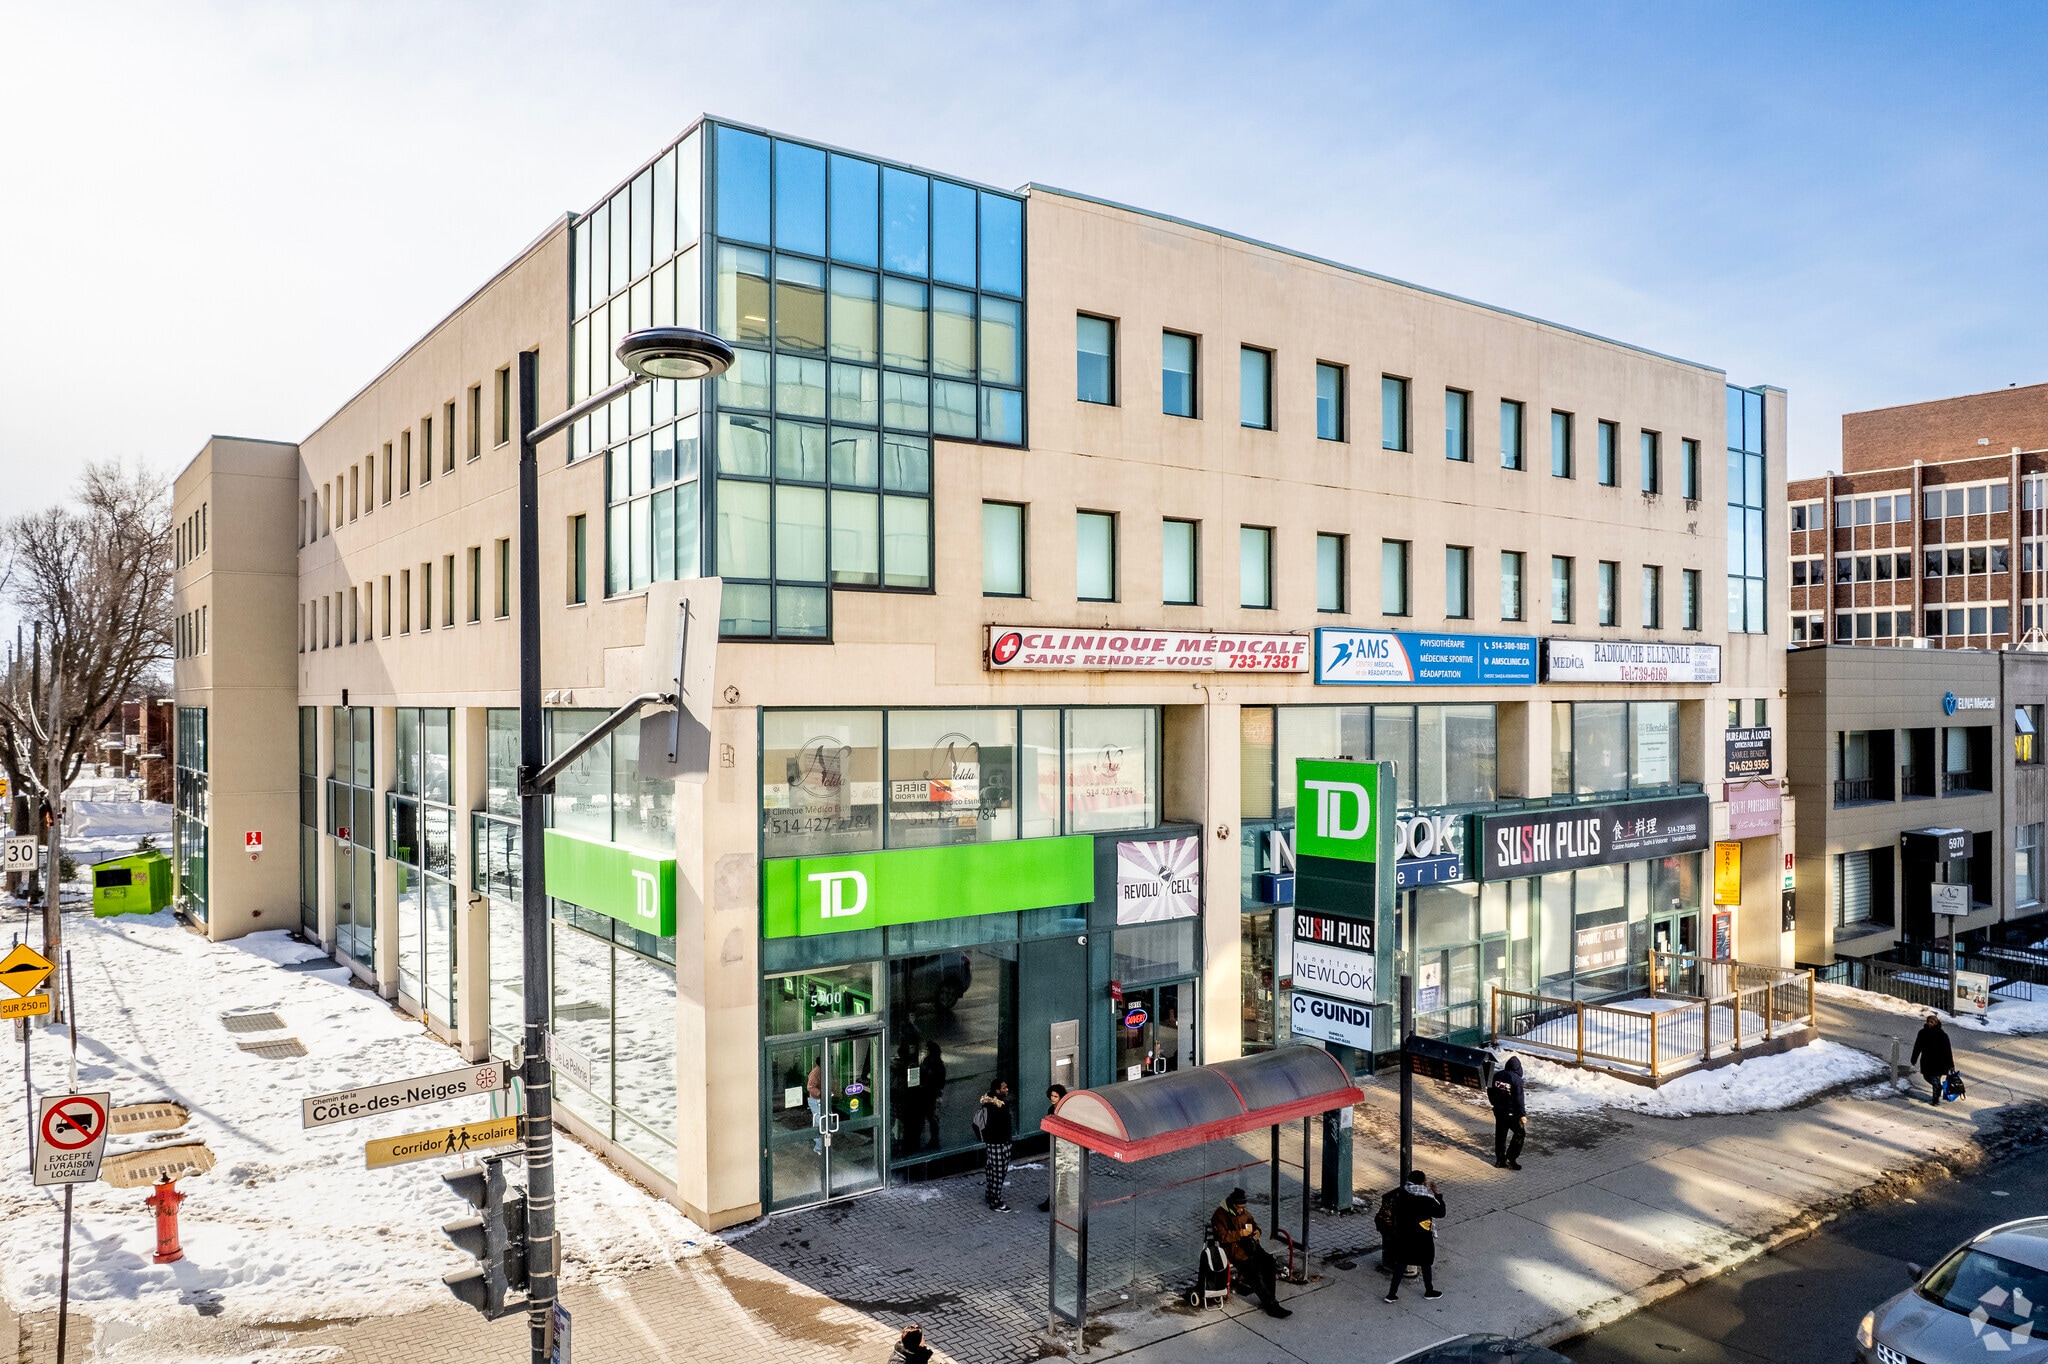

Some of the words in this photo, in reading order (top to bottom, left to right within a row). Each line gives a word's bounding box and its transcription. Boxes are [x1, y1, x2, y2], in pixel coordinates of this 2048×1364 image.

[1022, 634, 1167, 652] CLINIQUE
[1175, 635, 1307, 655] MÉDICALE
[1356, 638, 1389, 659] AMS
[1420, 638, 1465, 649] PHYSIOTHÉRAPIE
[1492, 641, 1530, 651] 514-300-1031
[1023, 653, 1076, 665] SANS
[1083, 654, 1213, 666] RENDEZ-VOUS
[1229, 654, 1299, 669] 733-7381
[1420, 653, 1448, 664] MÉDECINE
[1449, 655, 1474, 664] SPORTIVE
[1594, 644, 1643, 663] RADIOLOGIE
[1647, 645, 1691, 664] ELLENDALE
[1420, 668, 1462, 678] RÉADAPTATION
[1726, 731, 1750, 742] BUREAUX
[1756, 730, 1771, 740] LOUER
[1728, 759, 1770, 772] 514.629.9366
[1304, 779, 1372, 841] TD
[773, 818, 800, 834] 514
[1497, 822, 1550, 867] SUSHI
[1555, 818, 1600, 859] PLUS
[1948, 836, 1965, 850] 5970
[8, 844, 33, 862] 30
[631, 868, 658, 919] TD
[807, 870, 869, 919] TD
[1171, 878, 1192, 895] CELL
[1298, 915, 1334, 943] SUSHI
[1338, 920, 1371, 949] PLUS
[1296, 961, 1373, 992] NEWLOOK
[2, 1003, 20, 1014] SUR
[21, 1001, 38, 1011] 250
[39, 1001, 47, 1009] m
[1310, 1000, 1371, 1029] GUINDI
[312, 1096, 340, 1106] Chemin
[340, 1093, 350, 1101] de
[350, 1091, 357, 1099] la
[313, 1080, 467, 1122] Côte-des-Neiges
[392, 1138, 443, 1157] Corridor
[472, 1126, 515, 1142] scolaire
[49, 1150, 93, 1163] EXCEPTÉ
[43, 1160, 95, 1171] LIVRAISON
[51, 1168, 87, 1178] LOCALE
